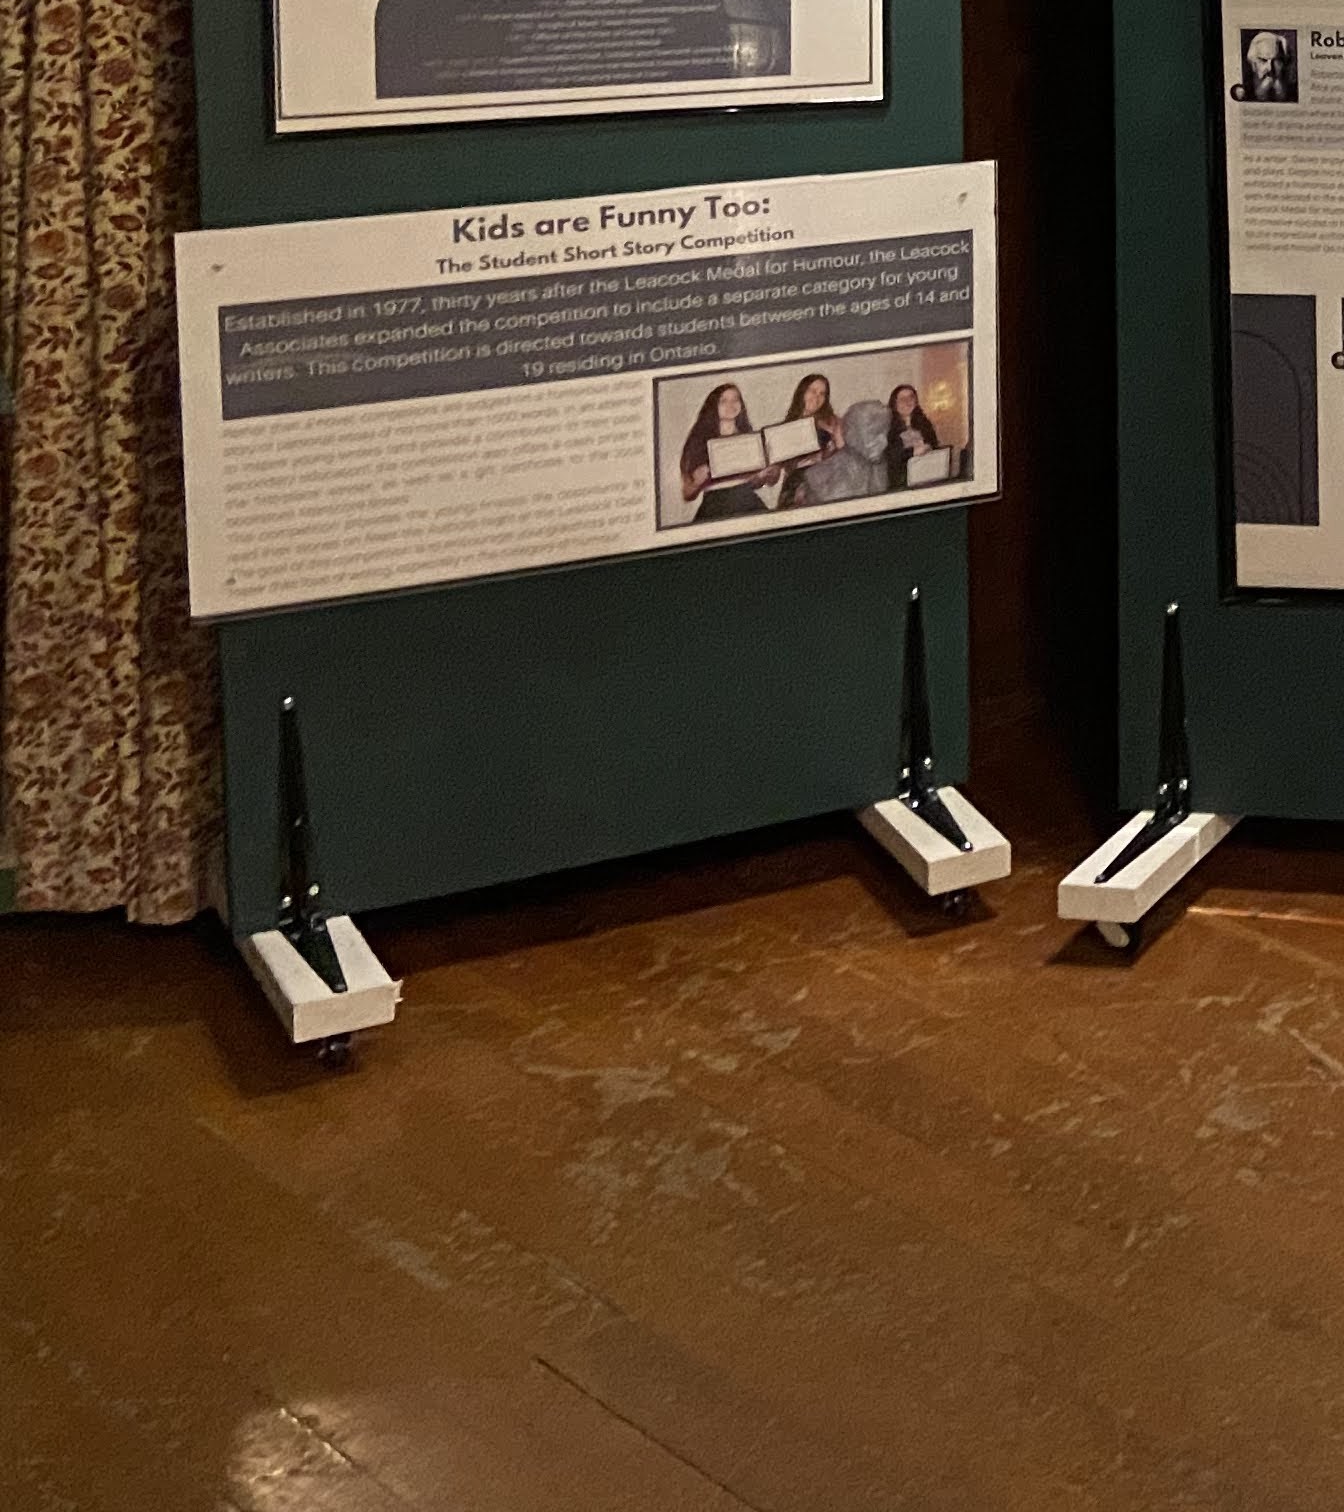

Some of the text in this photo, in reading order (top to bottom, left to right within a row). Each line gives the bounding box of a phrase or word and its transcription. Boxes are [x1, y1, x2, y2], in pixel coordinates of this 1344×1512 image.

[436, 227, 795, 274] The Student Short Story Competition
[453, 195, 770, 243] Kids are Funny Too:
[224, 240, 969, 332] Established in 1977, thirty years after the Leacock Medal for Humour, the Leacock
[354, 320, 454, 345] expanded
[459, 318, 490, 334] the
[494, 306, 609, 330] competition
[613, 303, 632, 316] to
[636, 294, 703, 313] include
[708, 293, 719, 306] a
[722, 285, 798, 304] separate
[802, 277, 877, 295] category
[880, 271, 903, 286] for
[906, 266, 959, 285] young
